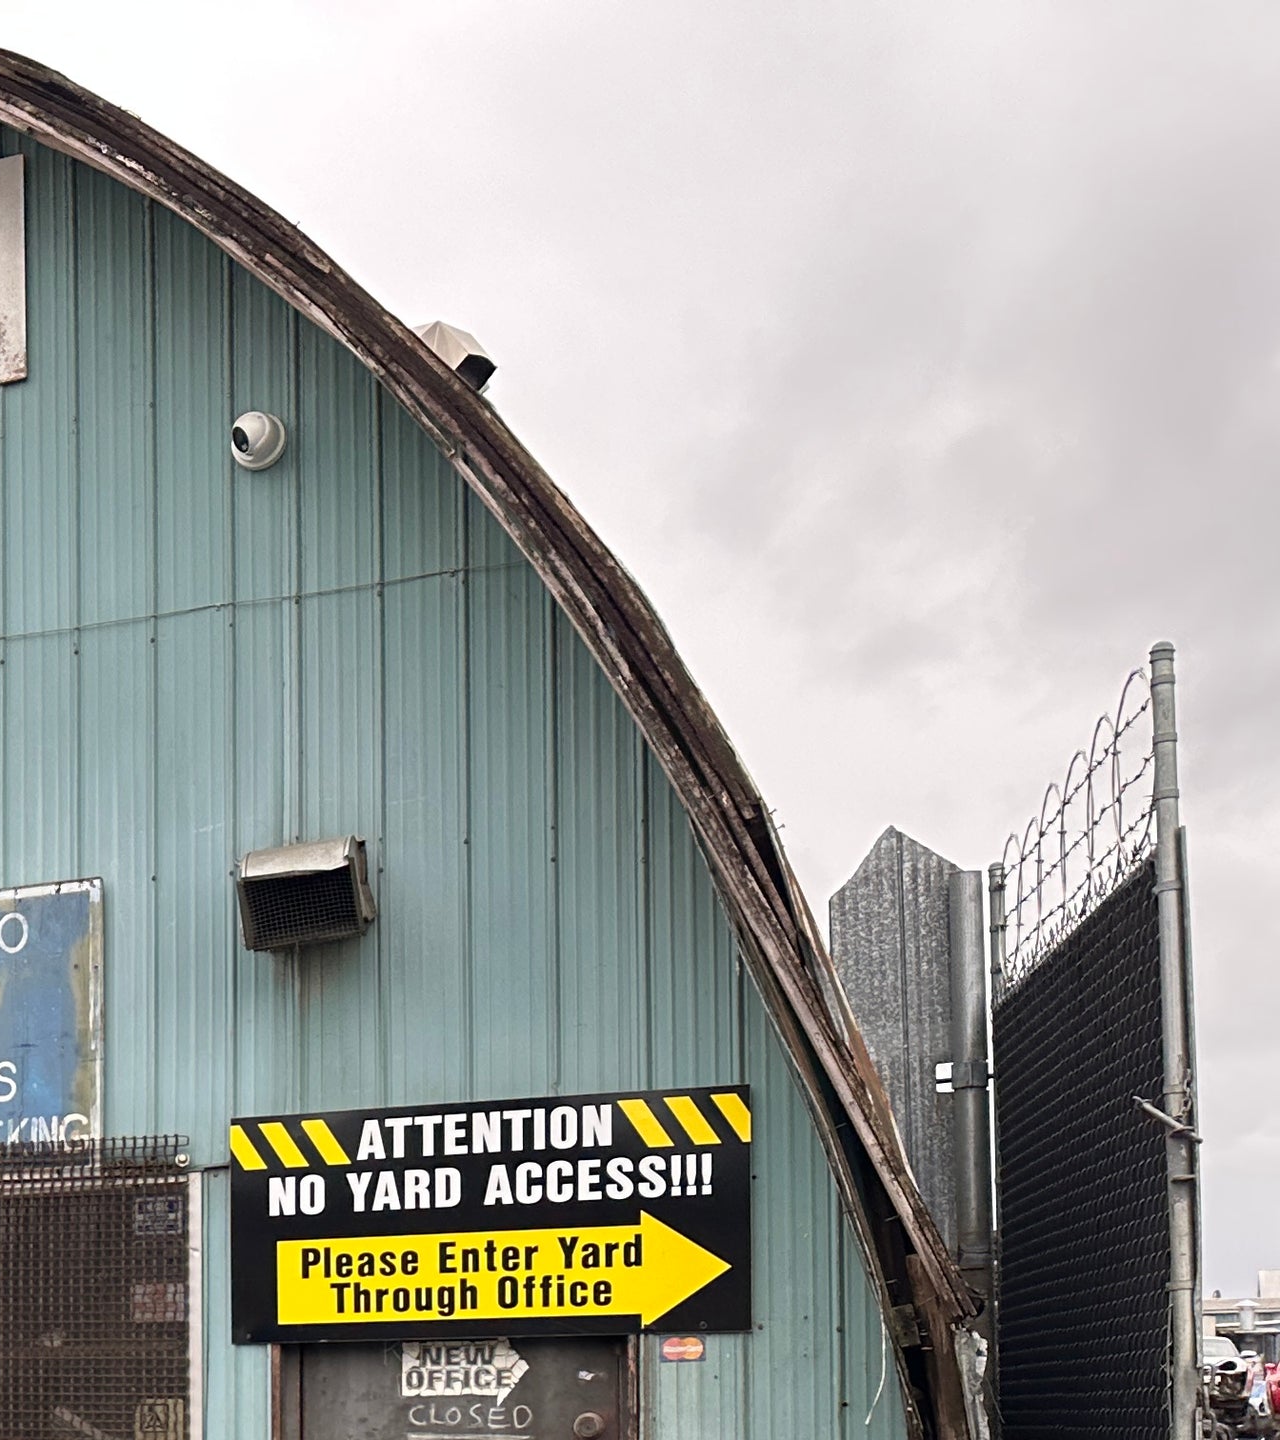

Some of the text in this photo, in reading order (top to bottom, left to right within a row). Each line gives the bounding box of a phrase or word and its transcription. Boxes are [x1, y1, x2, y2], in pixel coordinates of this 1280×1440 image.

[356, 1104, 613, 1161] ATTENTION
[268, 1153, 714, 1217] NO YARD ACCESS!!!
[301, 1234, 643, 1280] Please Enter Yard
[330, 1275, 613, 1317] Through Office
[420, 1344, 495, 1368] NEW
[404, 1366, 513, 1391] OFFICE
[408, 1403, 534, 1429] CLOSED
